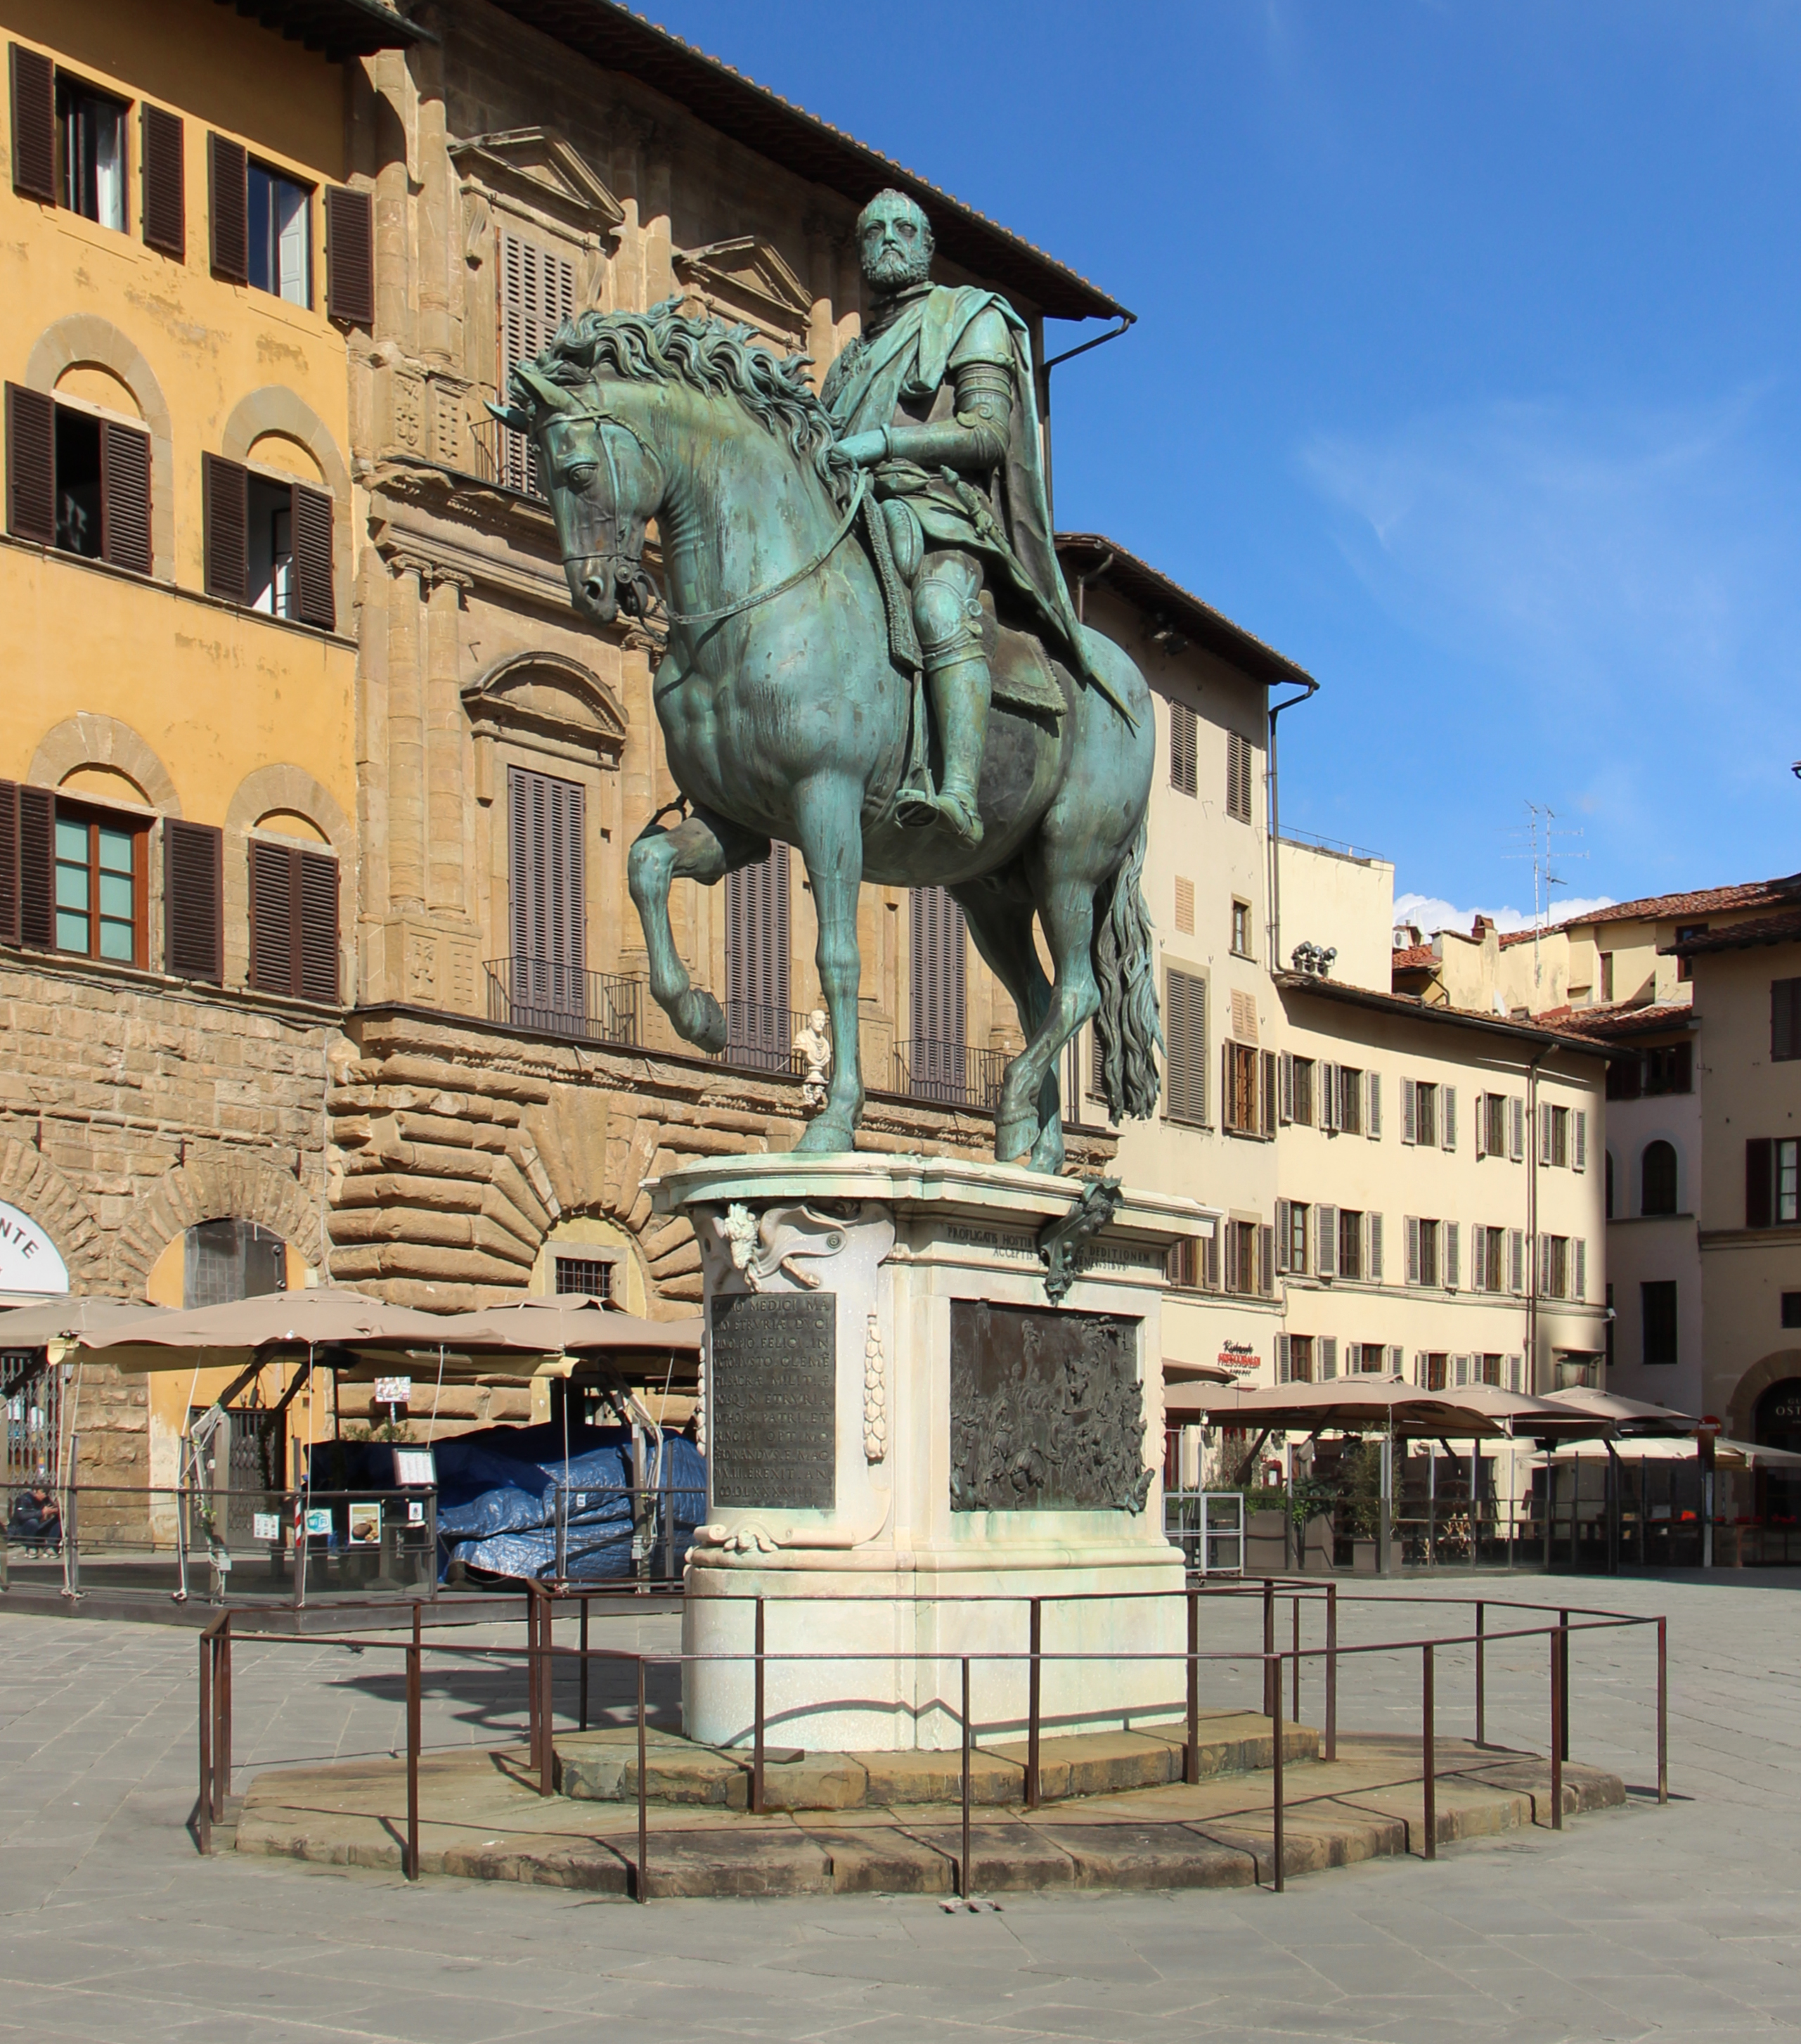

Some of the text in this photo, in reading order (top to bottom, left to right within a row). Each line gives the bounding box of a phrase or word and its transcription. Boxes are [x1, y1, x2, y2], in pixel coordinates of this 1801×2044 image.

[993, 1246, 1033, 1260] ACCEPTIS
[1089, 1245, 1150, 1263] DEDITIONEM
[750, 1300, 796, 1312] MEDICI
[765, 1393, 830, 1405] ETRVRIA
[811, 1412, 830, 1423] ET
